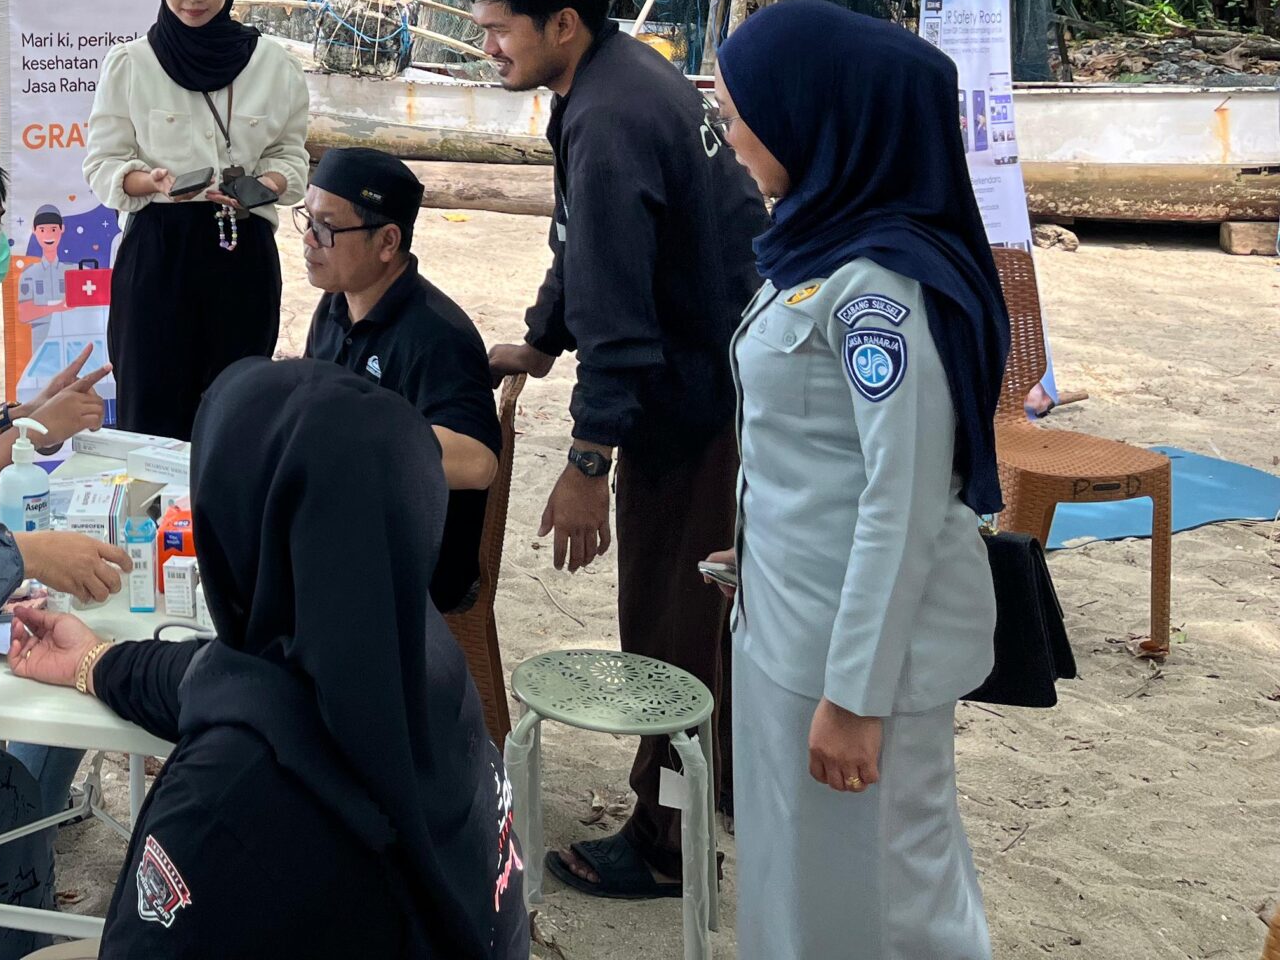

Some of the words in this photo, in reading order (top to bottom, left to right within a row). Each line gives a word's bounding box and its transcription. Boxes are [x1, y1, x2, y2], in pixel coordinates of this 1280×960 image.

[953, 10, 977, 25] Safety
[979, 10, 1002, 24] Road
[21, 32, 53, 48] Mari
[57, 32, 74, 49] ki,
[22, 55, 98, 70] kesehatan
[22, 78, 56, 93] Jasa
[60, 77, 99, 92] Raha
[22, 122, 89, 150] GRA
[842, 300, 869, 320] CABANG
[872, 301, 899, 317] SULSEL
[848, 337, 863, 348] JASA
[863, 335, 899, 352] RAHARJA
